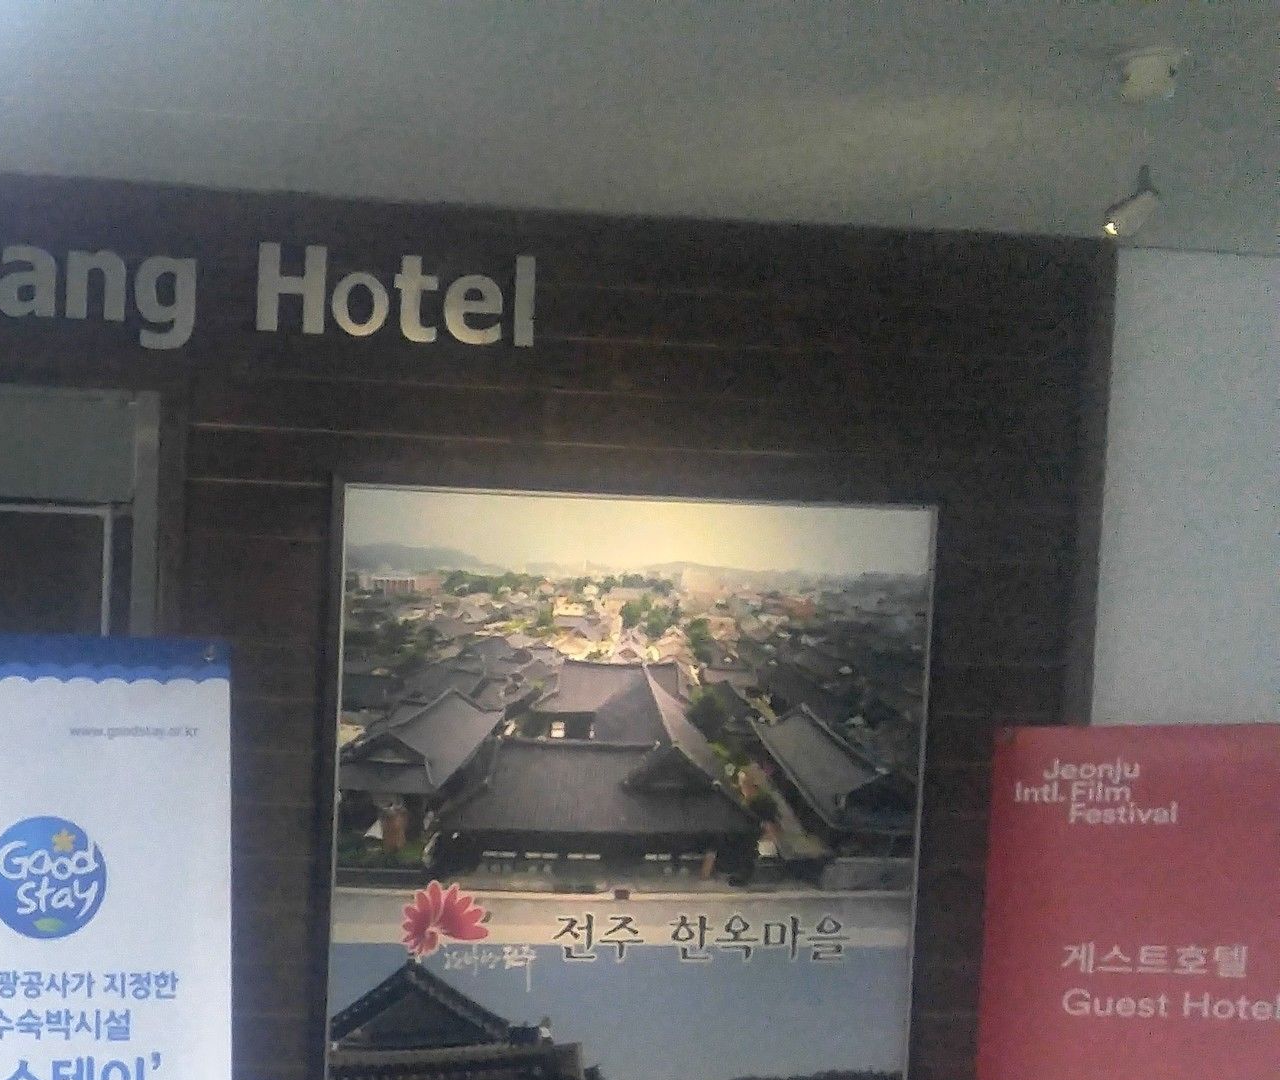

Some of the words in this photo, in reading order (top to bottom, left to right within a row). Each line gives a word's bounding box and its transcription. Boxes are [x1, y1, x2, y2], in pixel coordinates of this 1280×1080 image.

[255, 240, 537, 348] Hotel
[1042, 757, 1141, 784] Jeonju
[1071, 780, 1131, 803] Film
[1069, 800, 1178, 825] Festival
[552, 913, 646, 961] 전주
[669, 913, 852, 962] 한옥마을
[1061, 942, 1248, 979] 게스트호텔
[103, 970, 179, 1000] 지정한
[1062, 987, 1168, 1019] Guest
